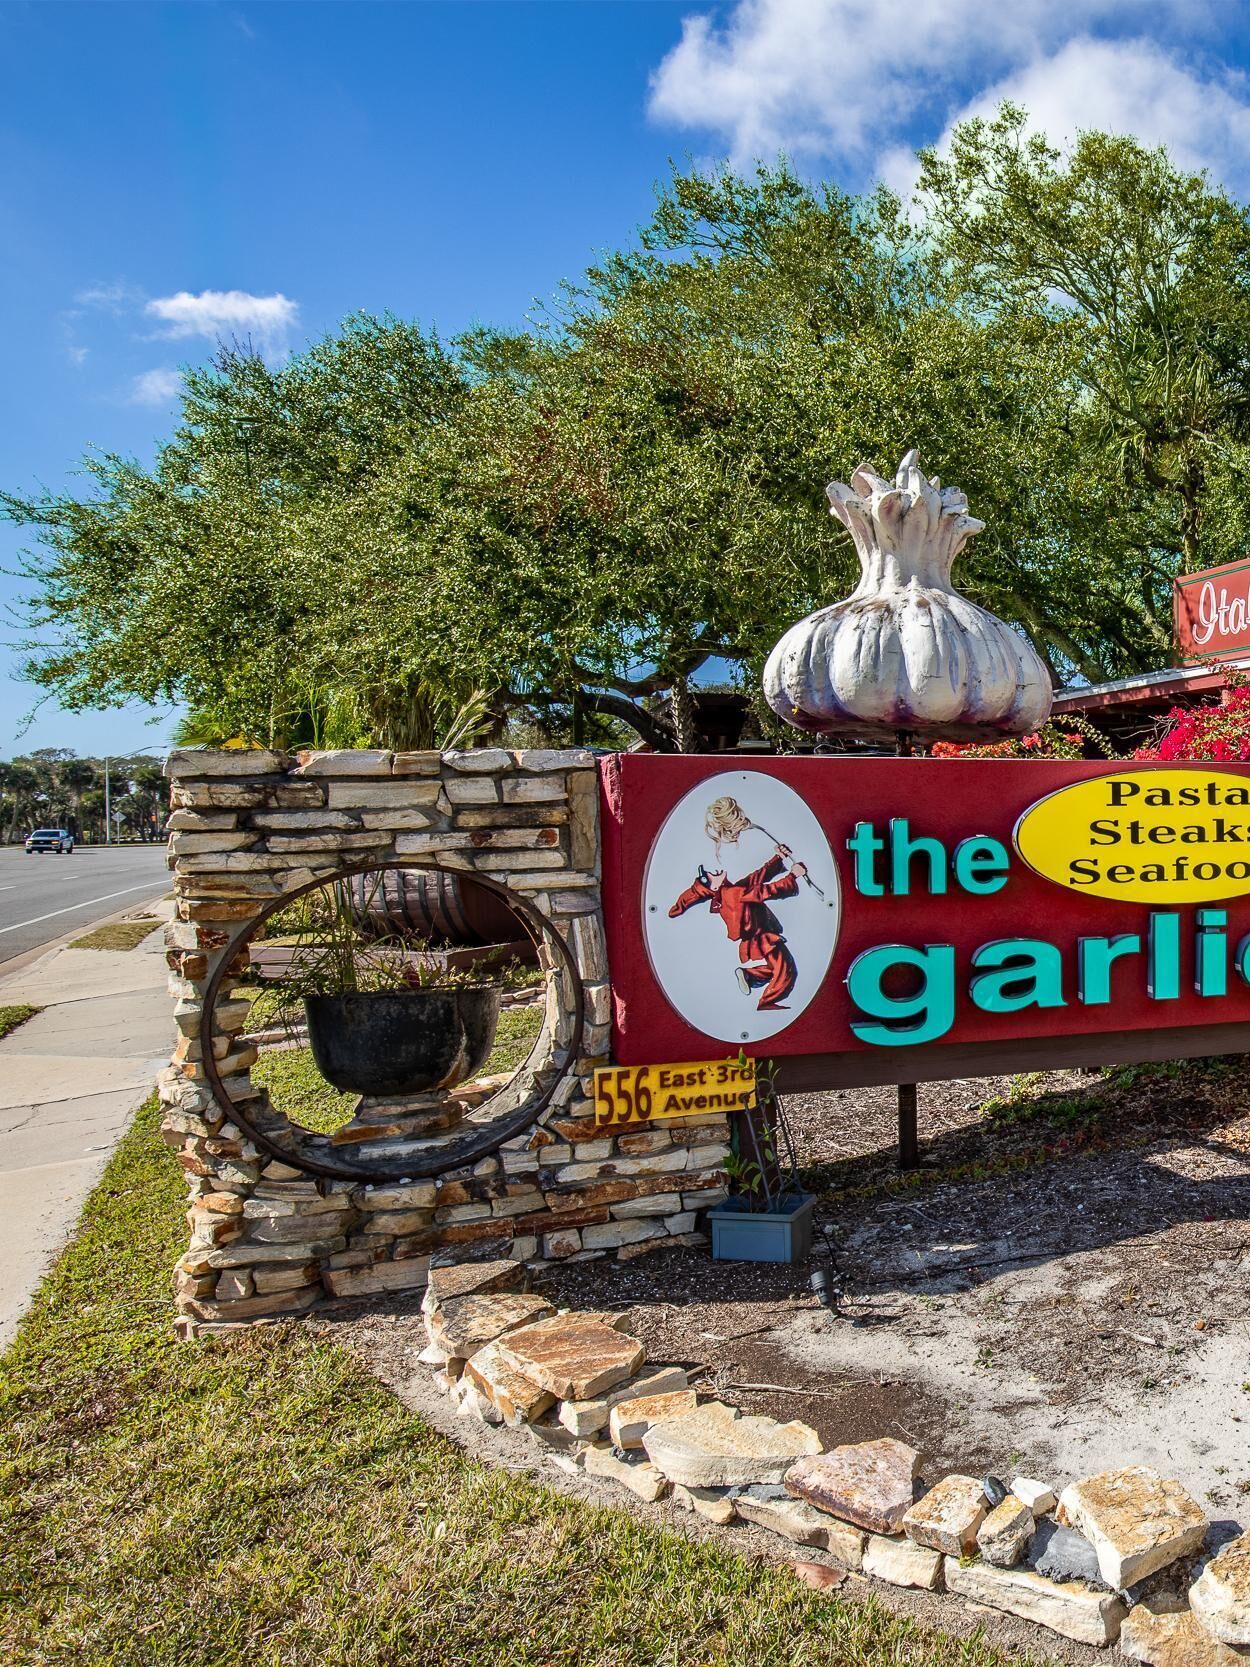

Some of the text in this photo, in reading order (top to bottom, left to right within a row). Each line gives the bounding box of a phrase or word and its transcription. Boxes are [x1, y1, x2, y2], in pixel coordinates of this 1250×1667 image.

[846, 817, 1010, 897] the
[598, 1067, 651, 1124] 556
[659, 1062, 754, 1089] East 3rd
